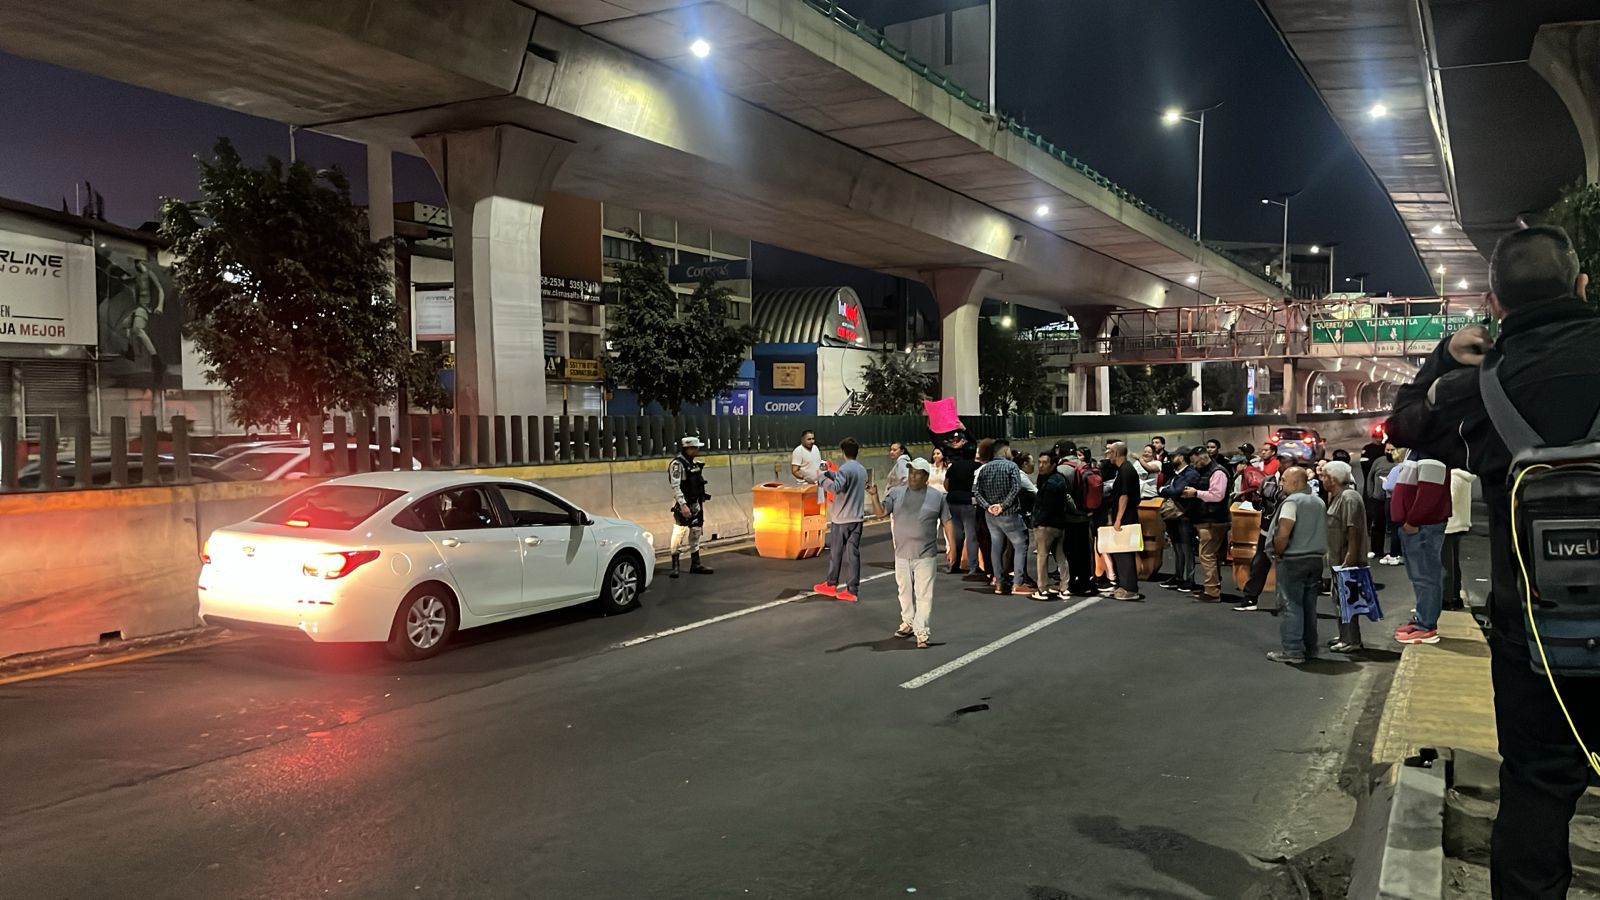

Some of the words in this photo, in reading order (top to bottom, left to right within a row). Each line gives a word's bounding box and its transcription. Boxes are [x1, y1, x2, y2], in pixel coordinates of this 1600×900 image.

[686, 264, 728, 278] Comx
[1365, 319, 1418, 327] TLLNPANTLA
[20, 323, 65, 337] MEJOR
[764, 400, 805, 412] Comex
